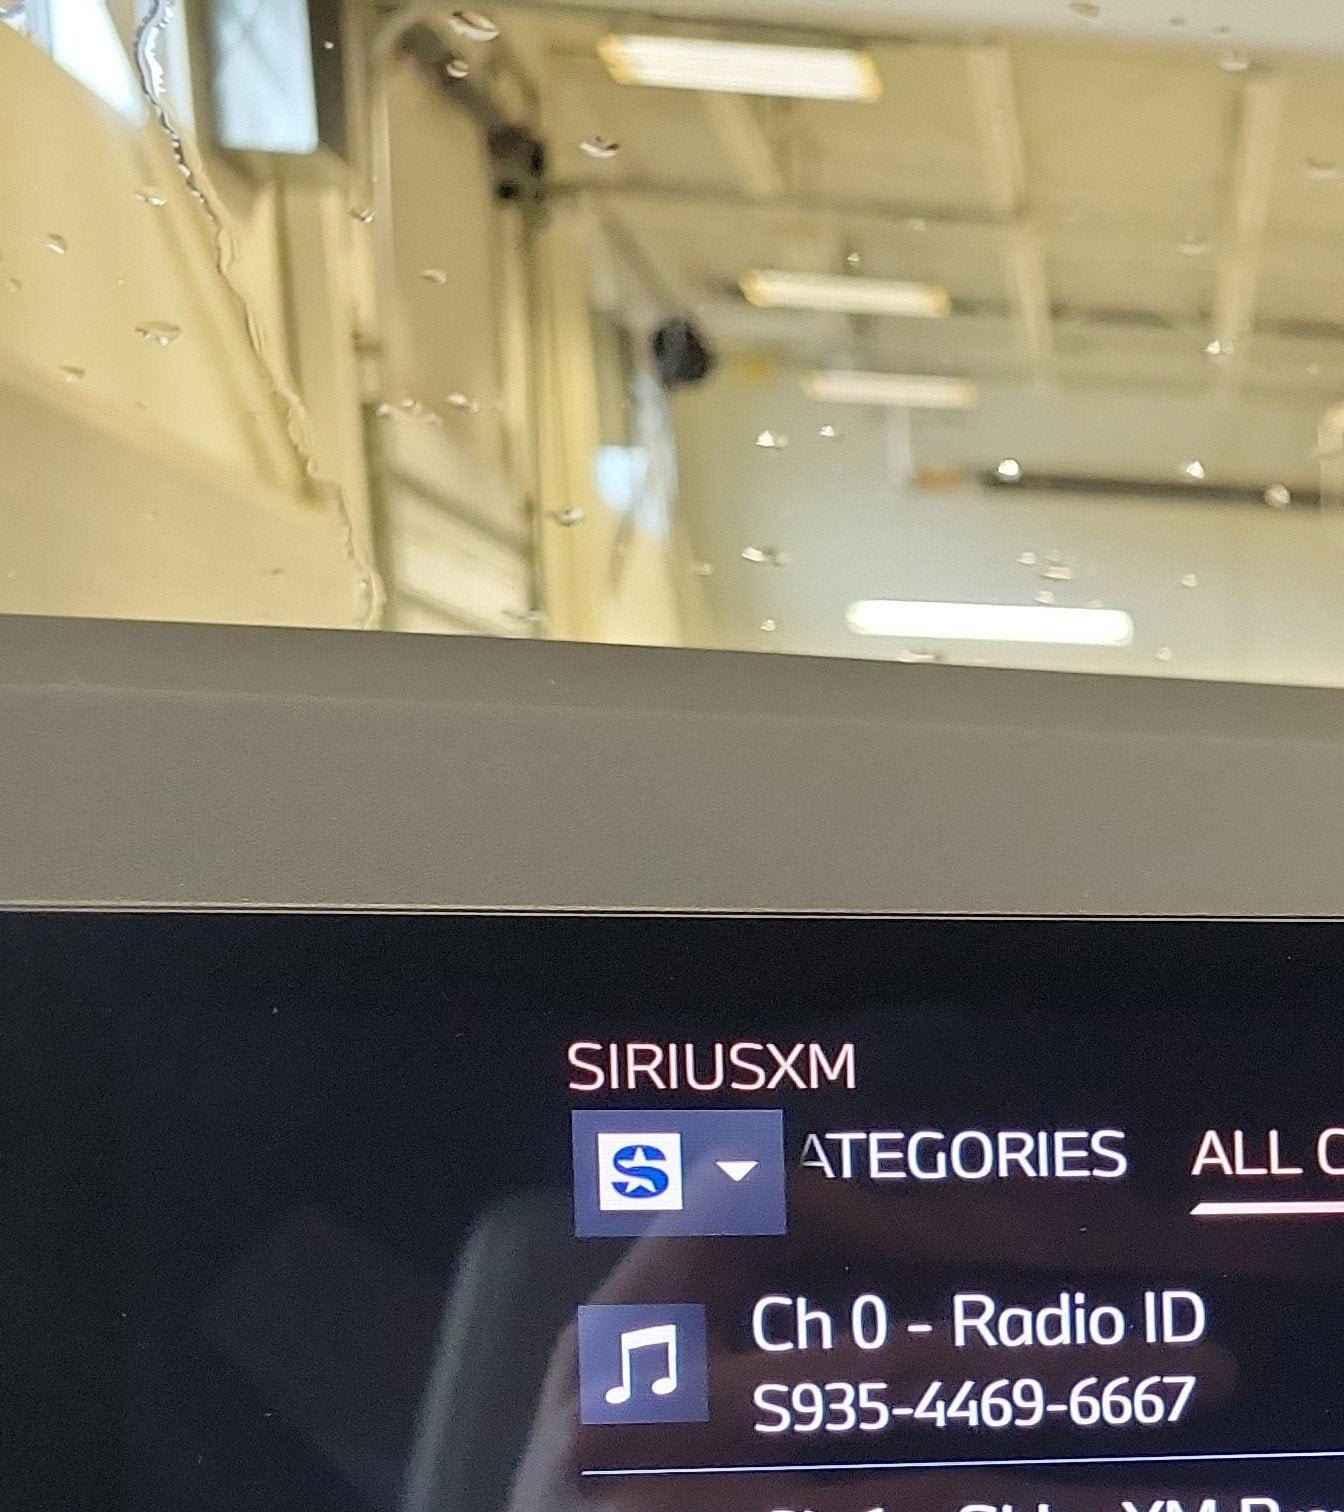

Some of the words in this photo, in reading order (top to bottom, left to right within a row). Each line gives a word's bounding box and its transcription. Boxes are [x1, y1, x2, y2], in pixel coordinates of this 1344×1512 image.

[567, 1041, 856, 1091] SIRIUSXM
[1190, 1129, 1304, 1176] ALL
[752, 1295, 833, 1352] Ch
[851, 1294, 888, 1350] 0
[953, 1291, 1126, 1348] Radio
[1144, 1290, 1206, 1343] ID
[753, 1375, 1197, 1434] S935-4469-6667
